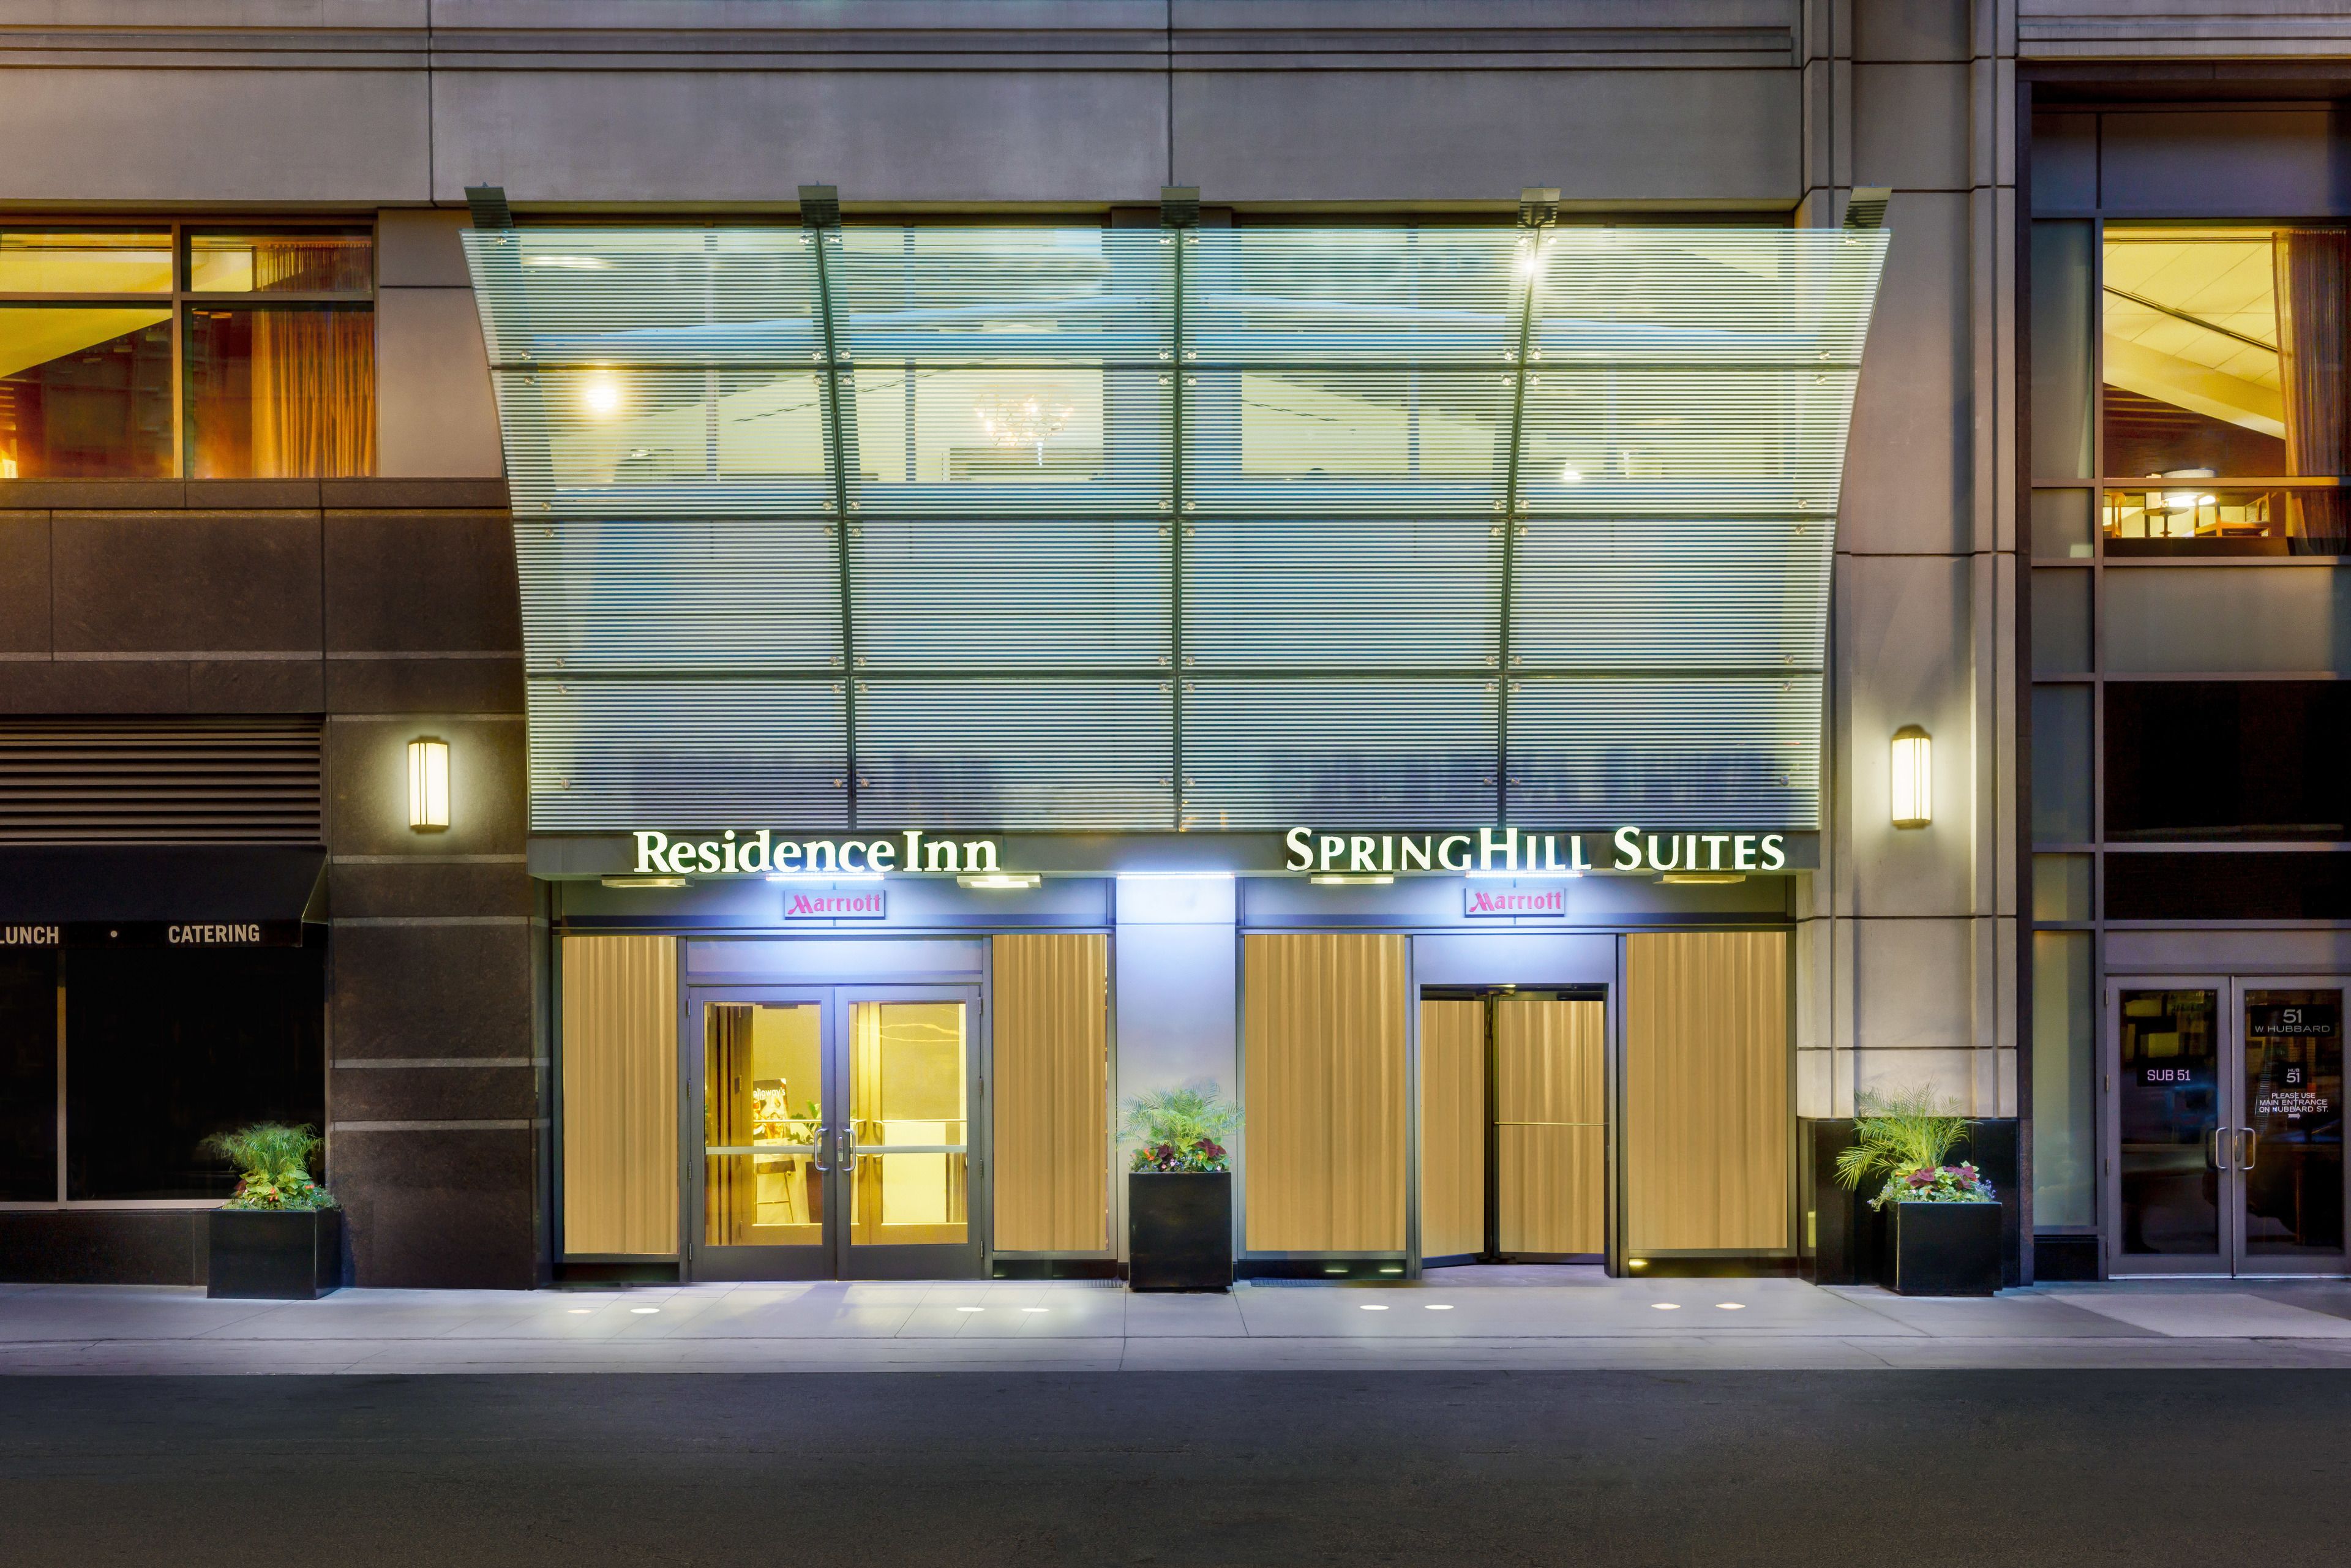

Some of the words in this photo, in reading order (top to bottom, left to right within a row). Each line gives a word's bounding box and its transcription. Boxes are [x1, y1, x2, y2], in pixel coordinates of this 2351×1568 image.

[632, 829, 896, 874] Residence
[902, 831, 1001, 872] Inn
[1286, 826, 1592, 872] SPRINGHILL
[1614, 826, 1785, 871] SUITES
[787, 894, 880, 914] Marriott
[1469, 891, 1561, 912] Marriott
[168, 924, 260, 943] CATERING
[2283, 1009, 2302, 1024] 51
[2147, 1070, 2173, 1081] SUB
[2177, 1069, 2191, 1081] 51
[2286, 1072, 2300, 1083] 51
